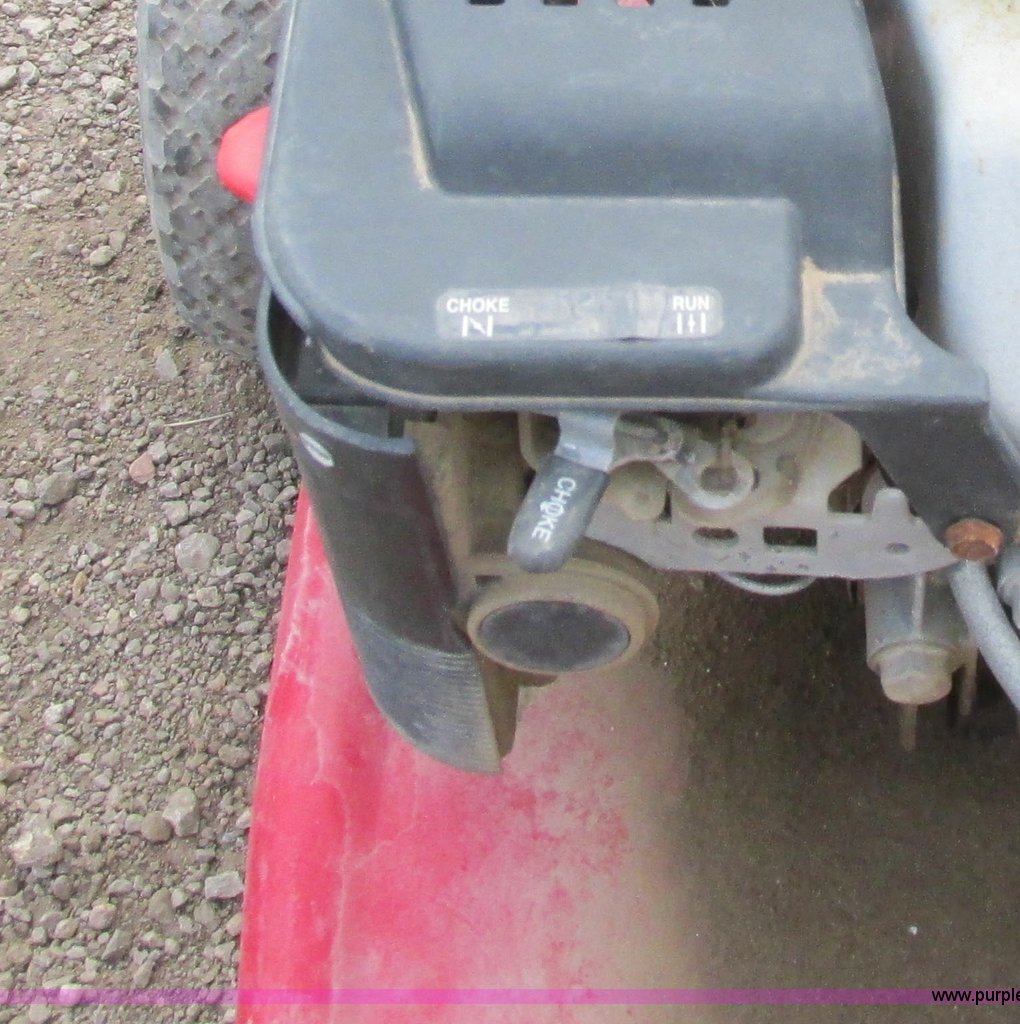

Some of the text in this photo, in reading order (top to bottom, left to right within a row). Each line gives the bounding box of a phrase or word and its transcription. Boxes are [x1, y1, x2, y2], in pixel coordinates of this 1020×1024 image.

[445, 294, 711, 314] CHOKE RUN
[531, 477, 576, 543] CHOKE
